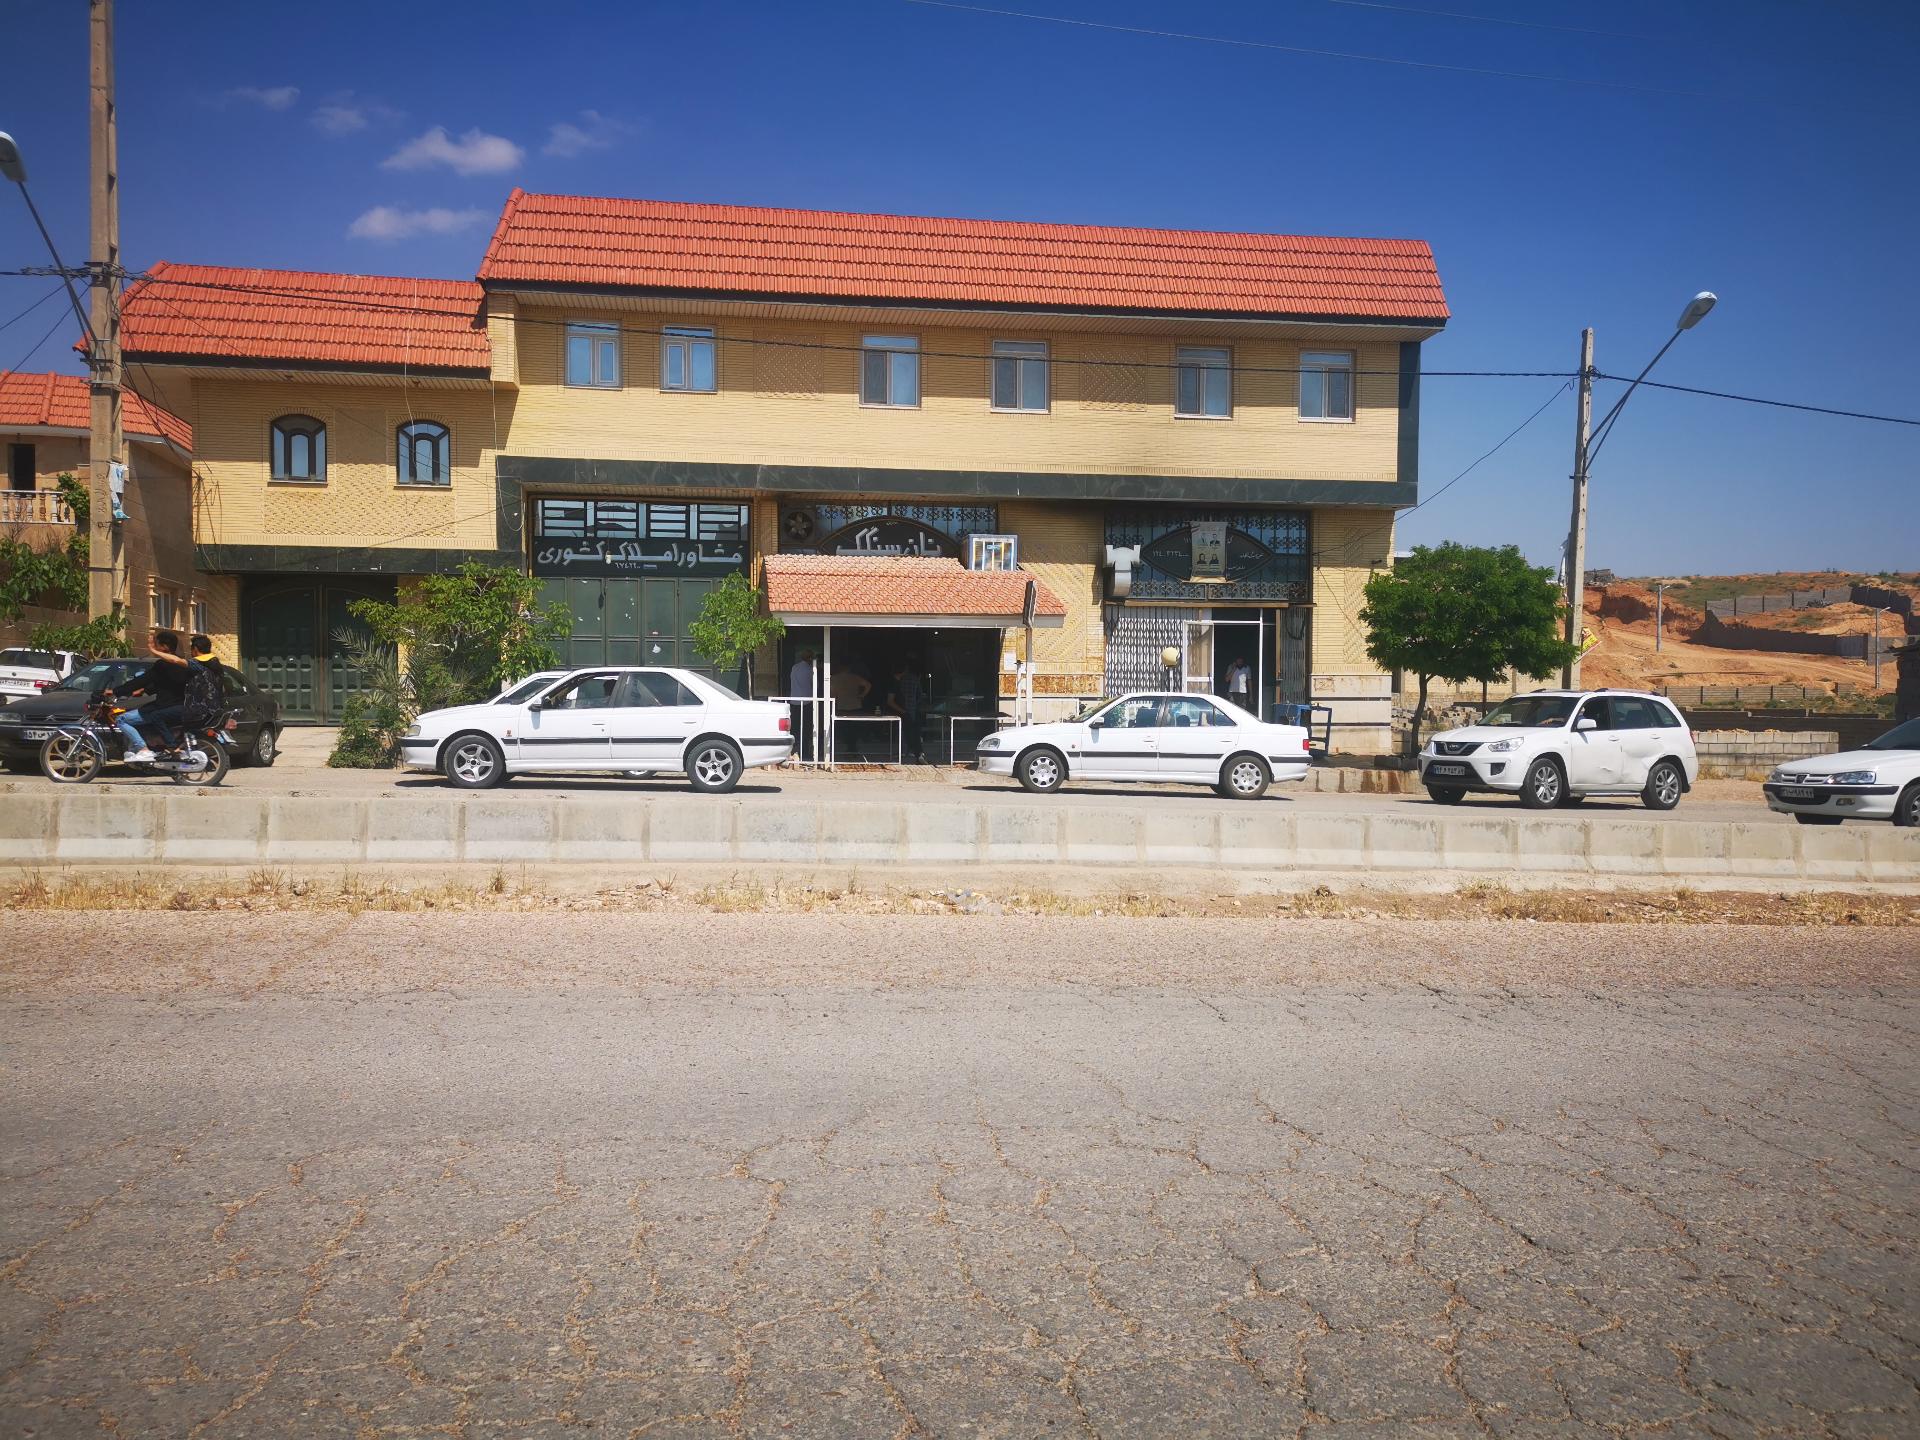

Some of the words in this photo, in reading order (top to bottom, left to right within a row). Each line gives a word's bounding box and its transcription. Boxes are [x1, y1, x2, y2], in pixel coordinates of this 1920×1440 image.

[605, 541, 678, 562] املاک
[836, 526, 902, 556] سنگک
[677, 543, 743, 569] مشاور
